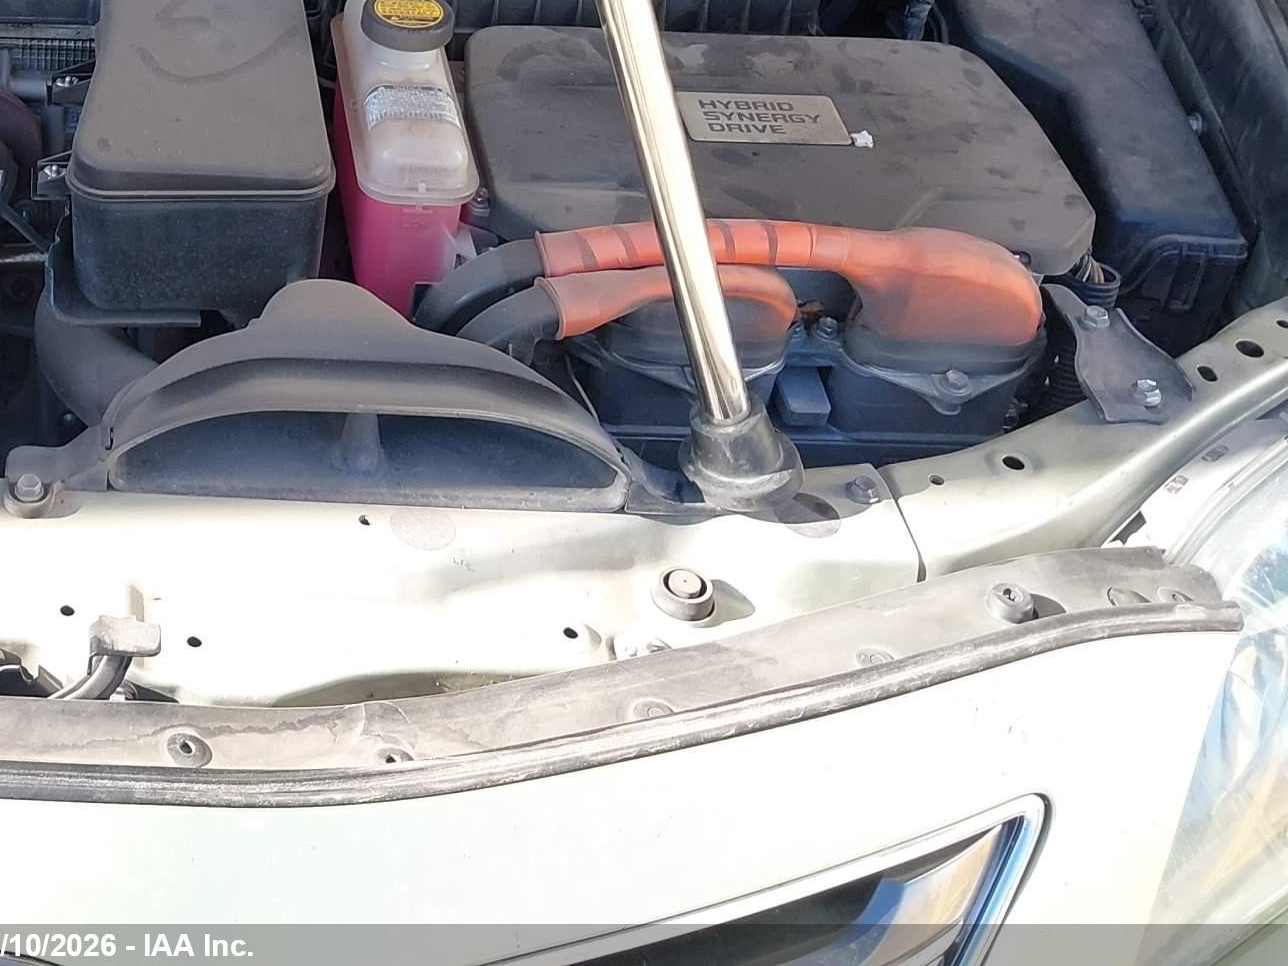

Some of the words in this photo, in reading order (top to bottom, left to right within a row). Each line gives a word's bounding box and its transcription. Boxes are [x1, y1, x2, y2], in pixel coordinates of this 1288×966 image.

[698, 99, 794, 111] HYBRID
[702, 111, 821, 124] SYNERGY
[708, 122, 786, 134] DRIVE
